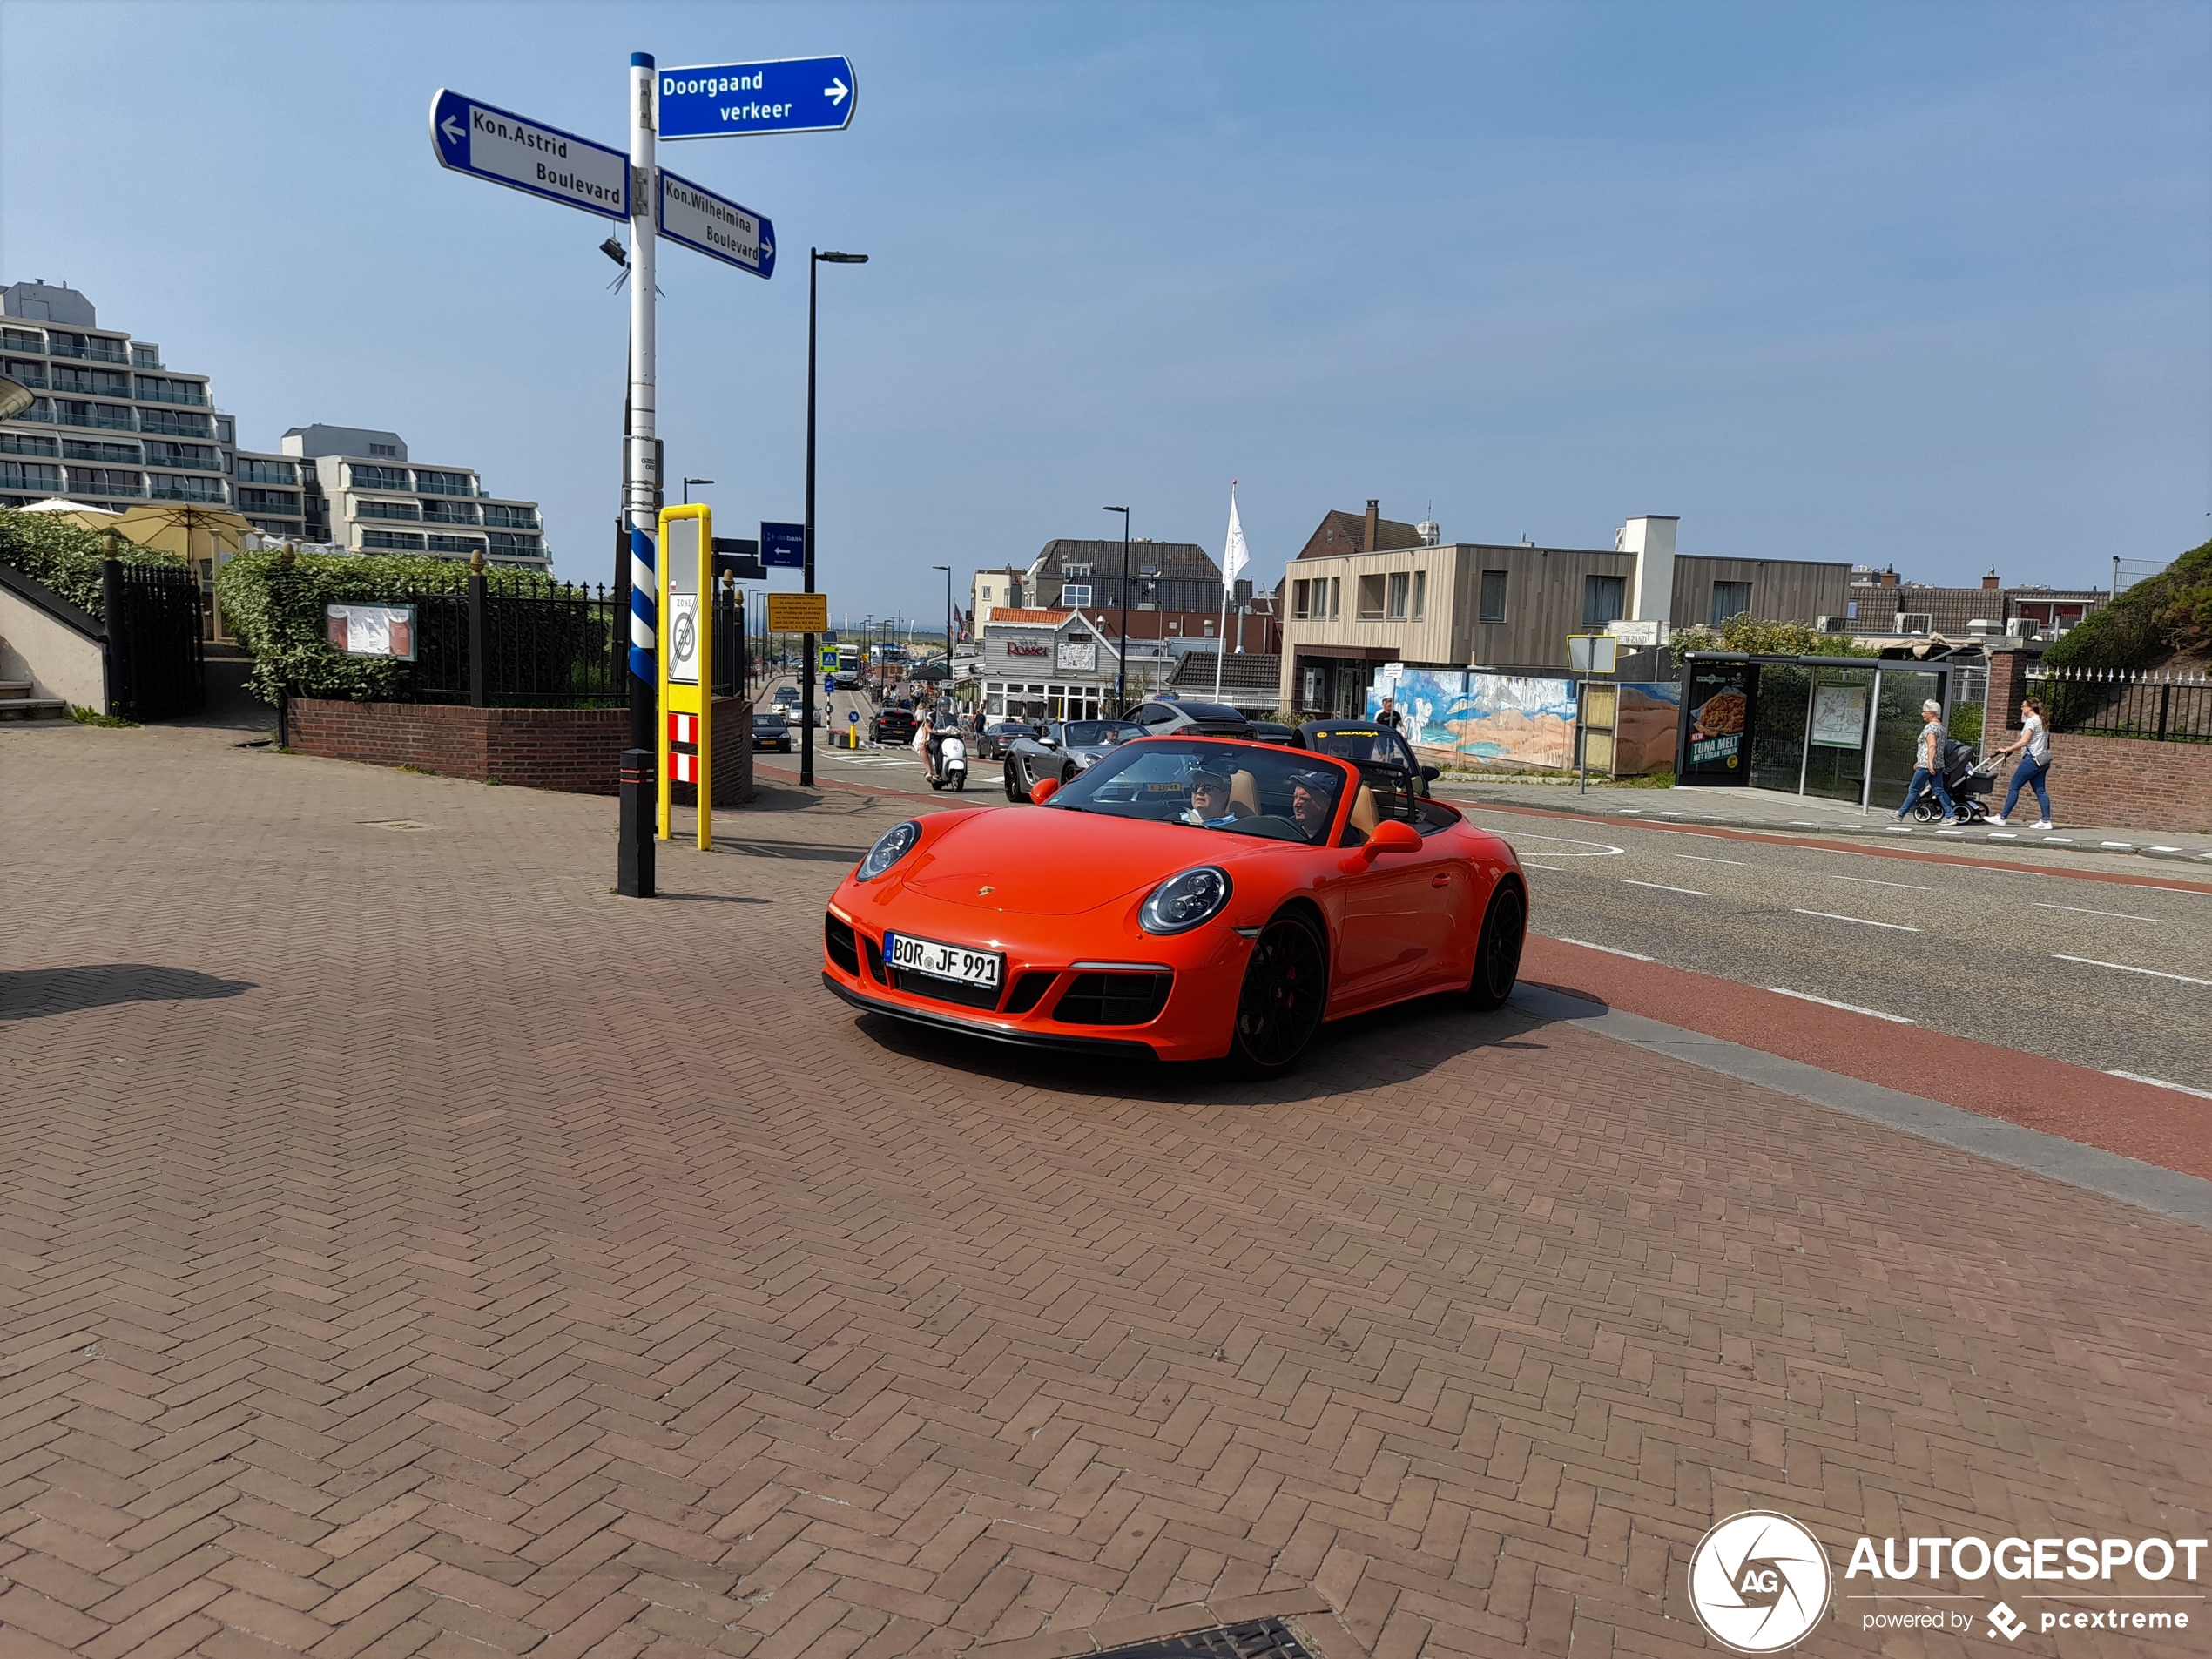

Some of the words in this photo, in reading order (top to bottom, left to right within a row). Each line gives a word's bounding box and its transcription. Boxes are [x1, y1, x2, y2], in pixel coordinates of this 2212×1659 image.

[663, 71, 763, 98] Doorgaand
[720, 102, 792, 121] verkeer
[472, 112, 568, 158] Kon.Astrid
[536, 163, 621, 205] Boulevard
[664, 180, 752, 233] Kon.Wilhelmina
[706, 226, 759, 261] Boulevard
[677, 598, 691, 607] ZONE
[1691, 732, 1703, 741] NEW
[1693, 740, 1716, 754] TUNA
[1717, 735, 1739, 751] MELT
[1704, 751, 1720, 759] VEGAN
[894, 938, 924, 967] BOR
[936, 948, 959, 973] JF
[963, 954, 996, 981] 991
